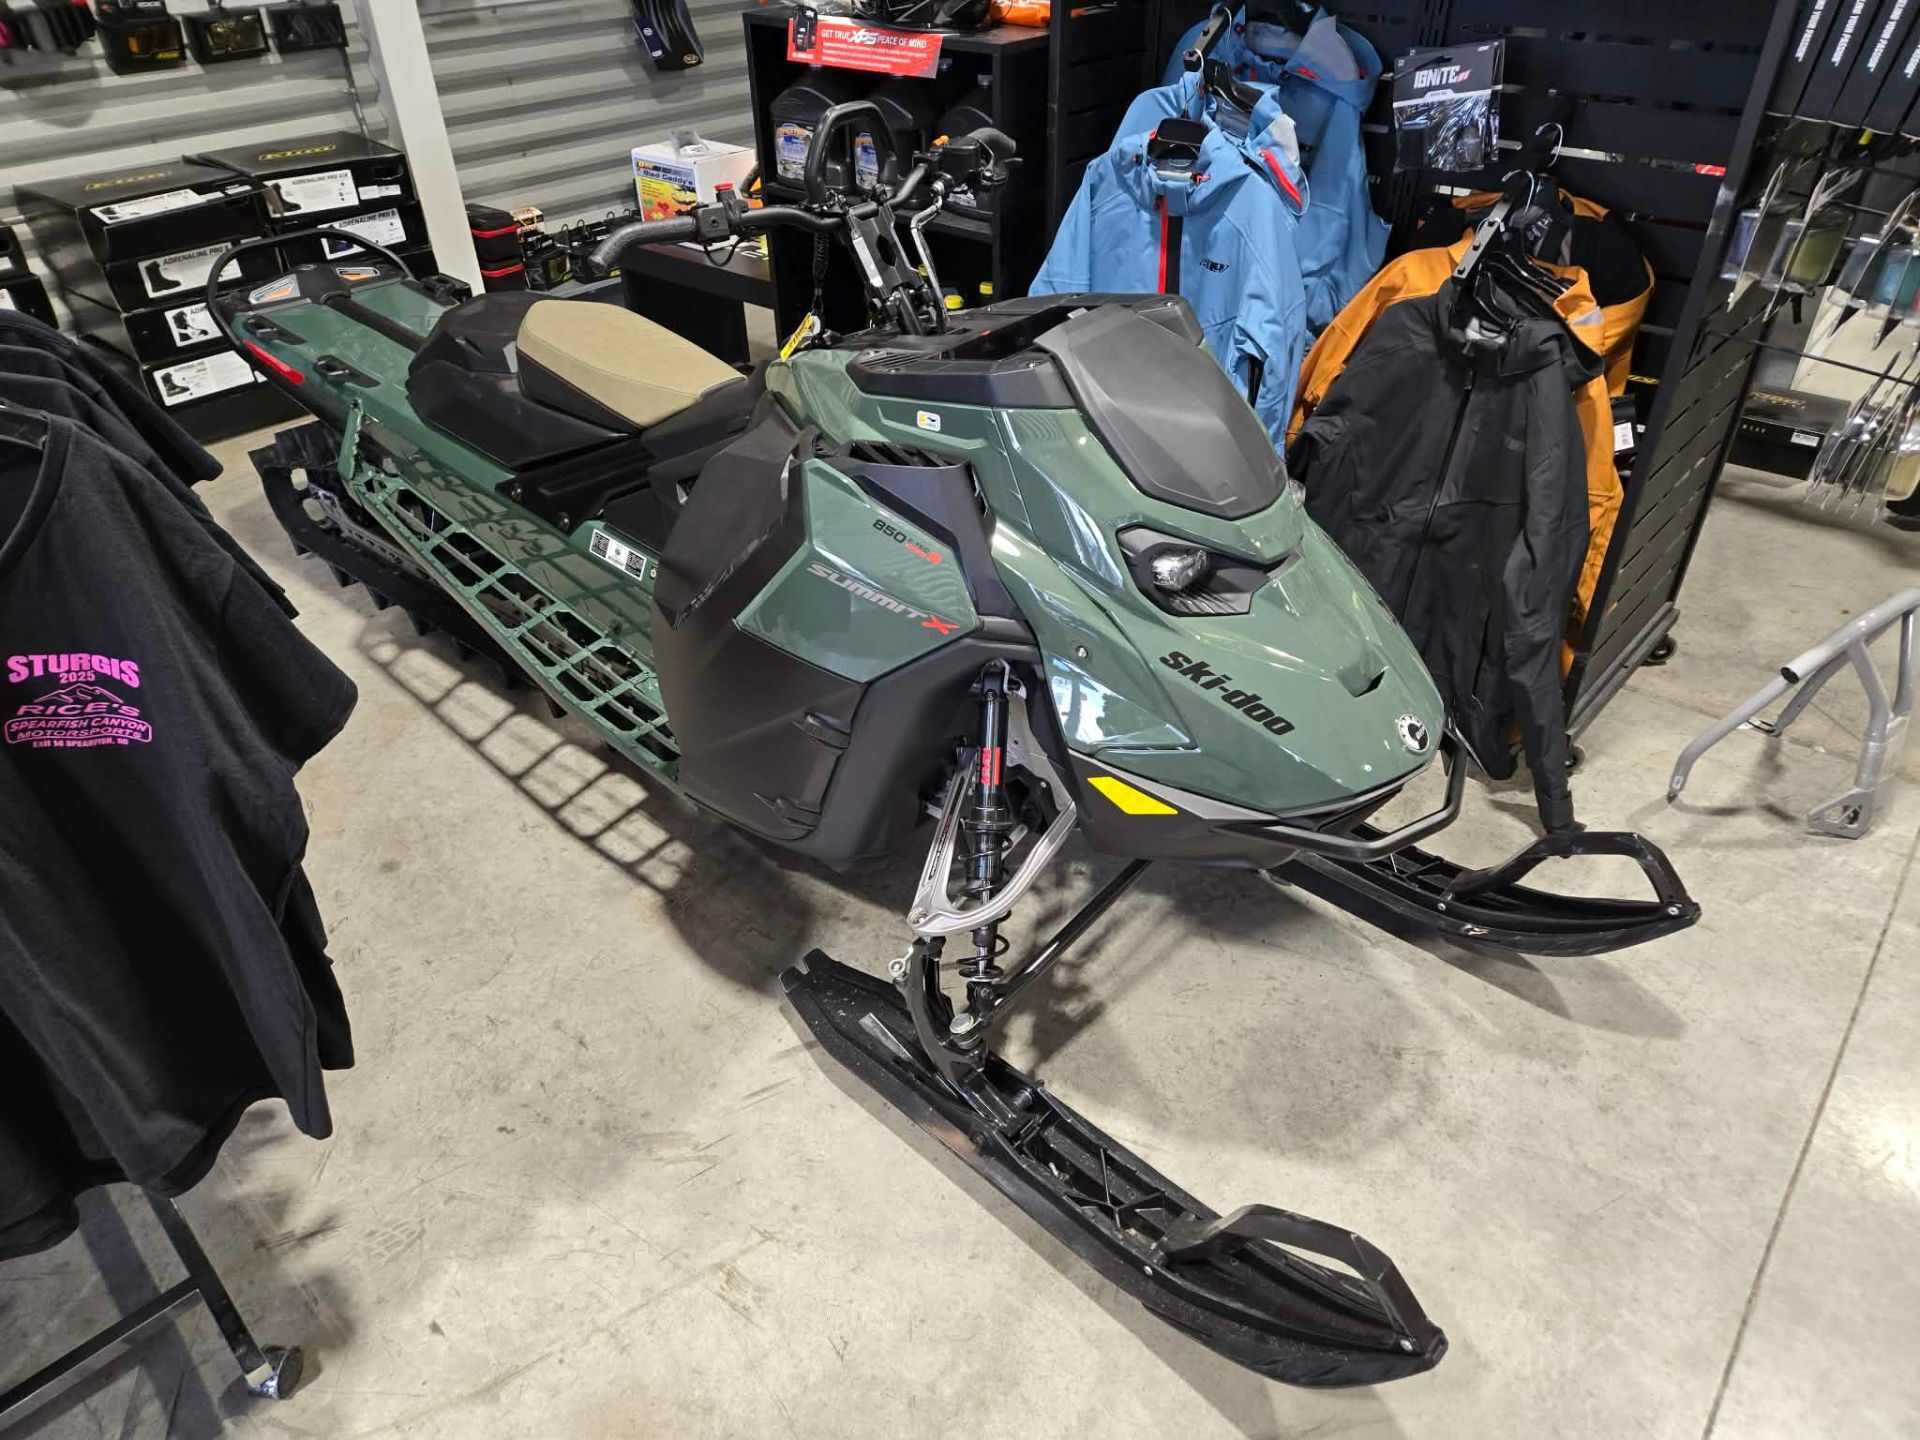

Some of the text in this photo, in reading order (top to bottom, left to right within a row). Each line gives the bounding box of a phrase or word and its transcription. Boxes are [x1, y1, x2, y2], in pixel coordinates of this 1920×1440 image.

[821, 28, 927, 49] GET TRUE XPS PEACE OF MIND
[1413, 65, 1461, 89] IGNITE
[339, 215, 377, 228] ADRENALINE
[378, 212, 391, 220] PRO
[162, 250, 208, 266] ADRENALINE
[209, 246, 224, 255] PRO
[872, 519, 907, 544] 850
[806, 562, 960, 635] SUMMIT X
[7, 653, 140, 688] STURGIS
[60, 671, 96, 684] 2025
[1159, 651, 1295, 735] ski-doo
[17, 702, 141, 717] RICE'S
[10, 718, 147, 732] SPEARFISH CANYON
[16, 728, 143, 740] MOTORSPORTS
